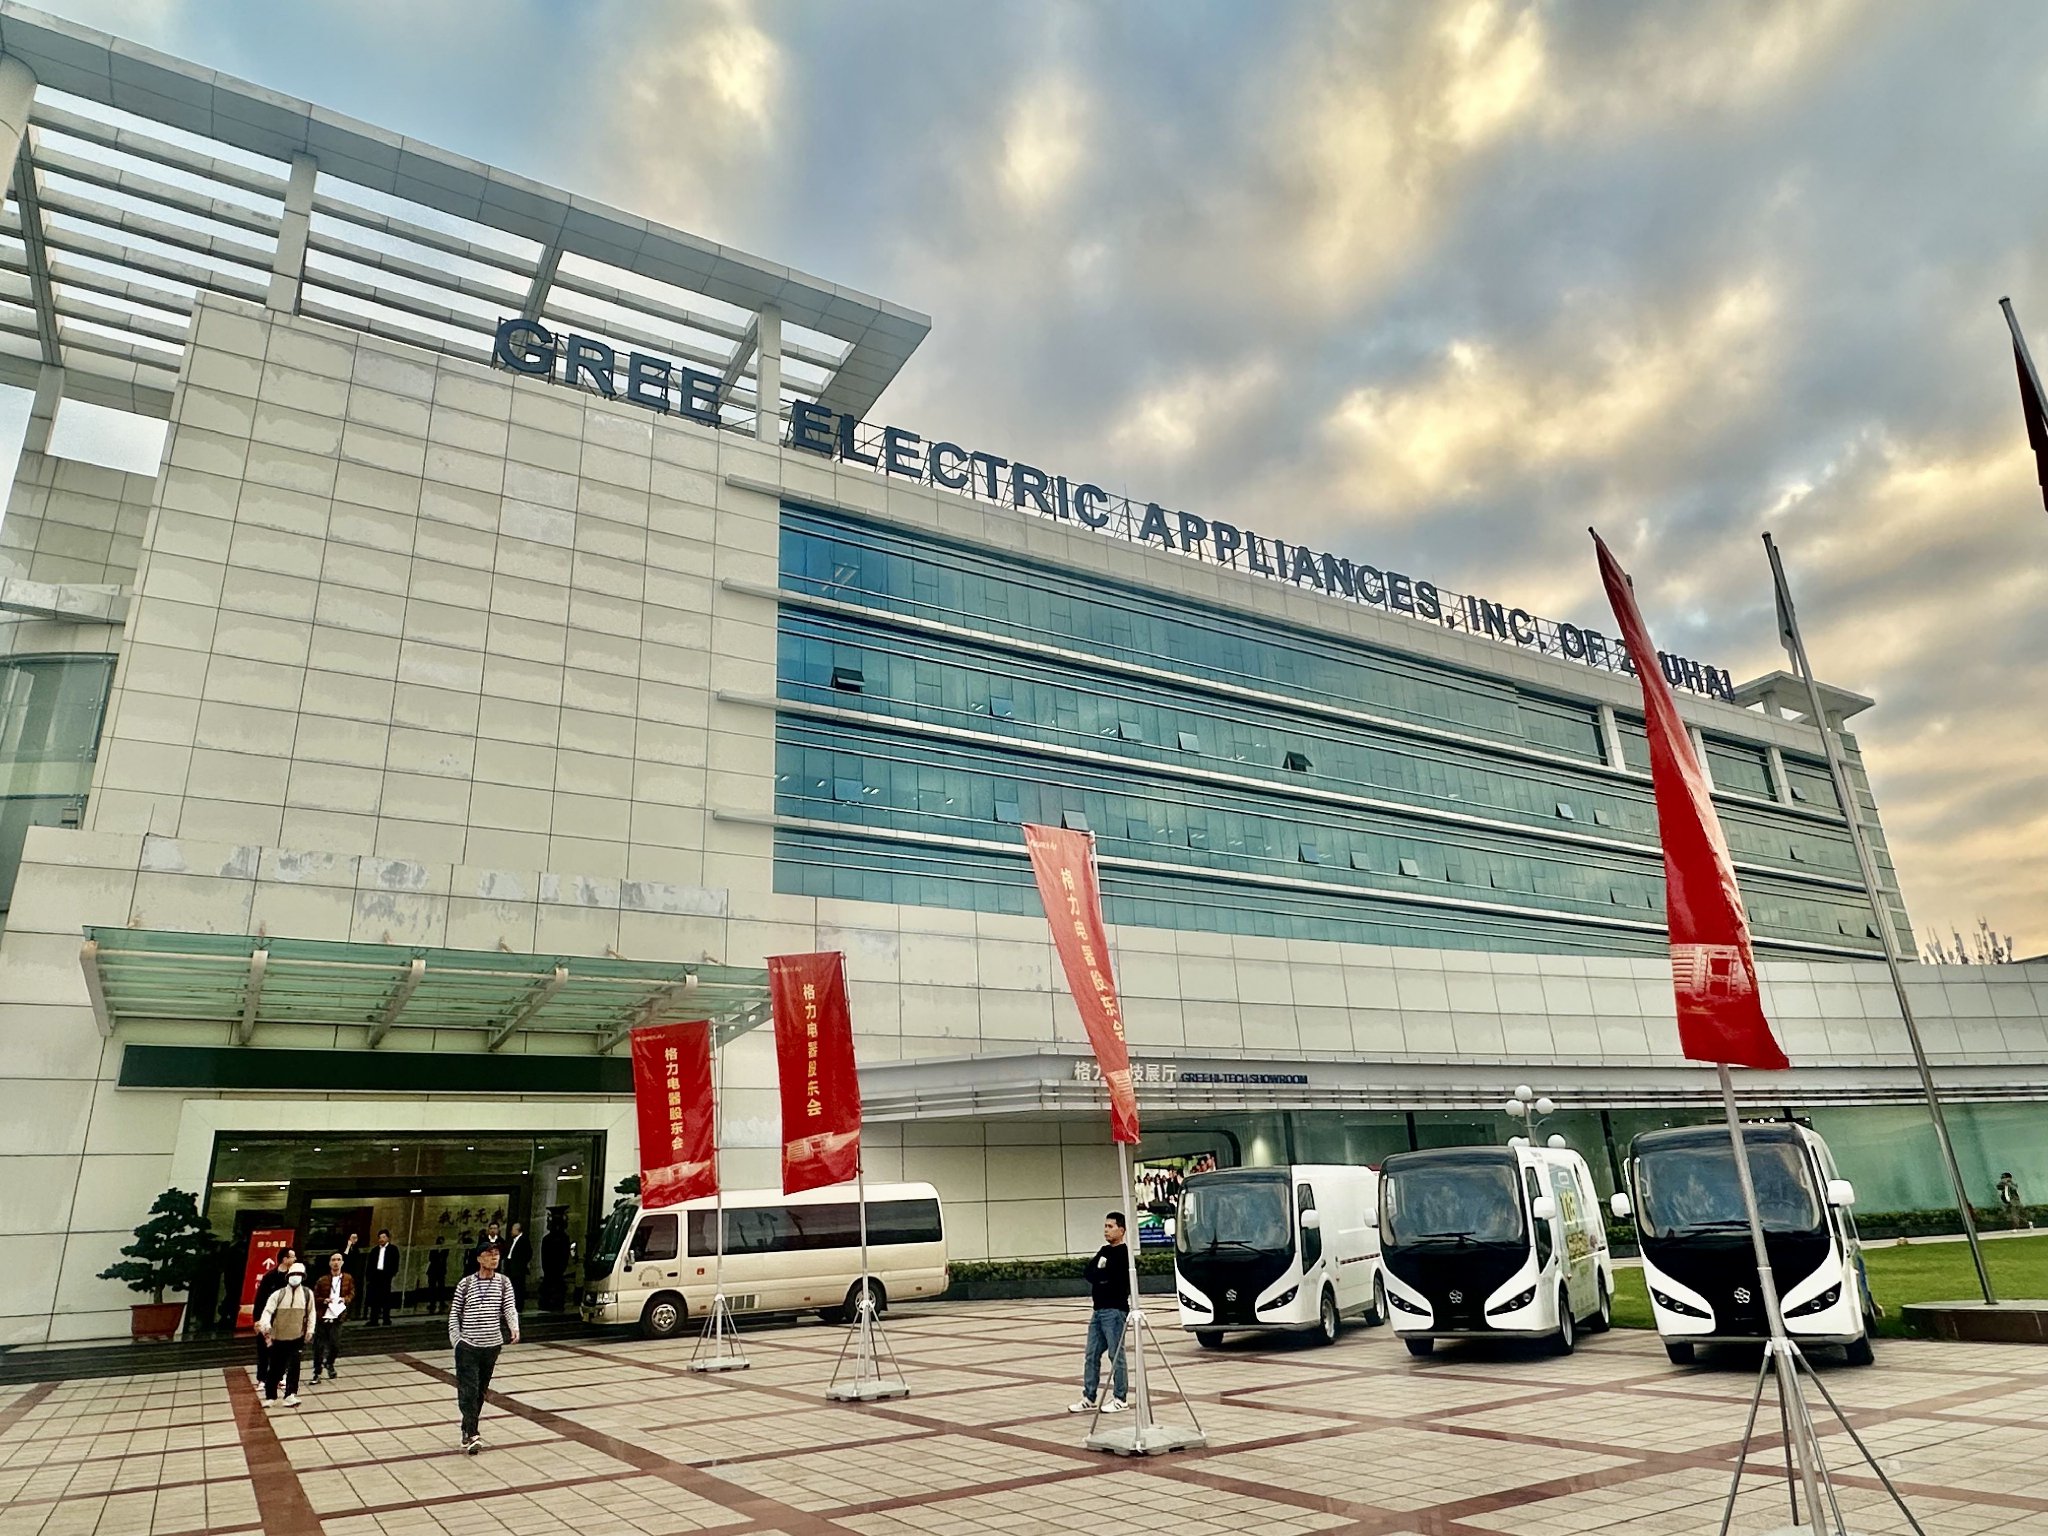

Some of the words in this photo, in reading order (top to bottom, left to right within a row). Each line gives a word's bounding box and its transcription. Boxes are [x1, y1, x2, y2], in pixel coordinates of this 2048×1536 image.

[497, 318, 721, 425] GREE
[793, 400, 1109, 527] ELECTRIC
[1139, 503, 1454, 629] APPLIANCES,
[1468, 595, 1546, 649] INC.
[1559, 623, 1602, 663] OF
[1616, 639, 1735, 700] ZUHAI
[665, 1047, 684, 1150] 格力电器股东会
[803, 983, 822, 1116] 格力电器股东会
[1074, 1061, 1177, 1081] 格力技展厅
[1181, 1073, 1209, 1082] GREE
[1249, 1074, 1308, 1084] SHOWROOM
